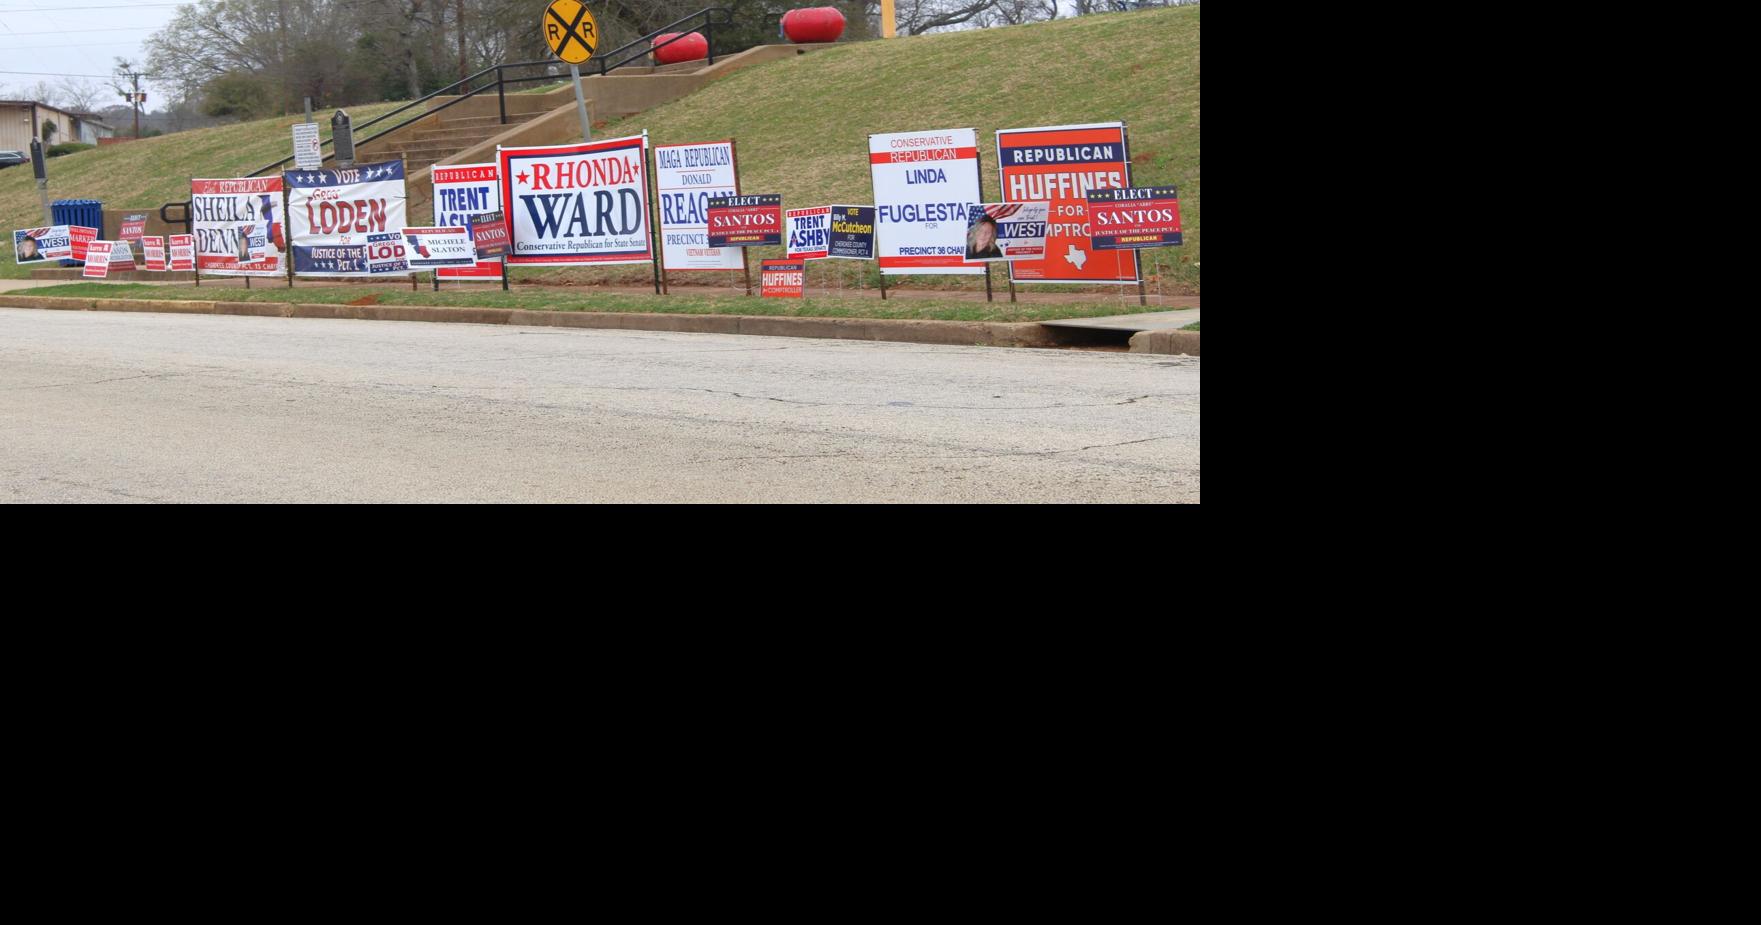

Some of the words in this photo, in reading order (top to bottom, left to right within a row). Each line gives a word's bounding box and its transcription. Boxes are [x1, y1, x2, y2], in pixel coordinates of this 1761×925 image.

[548, 24, 560, 40] R
[582, 22, 594, 38] R
[891, 136, 952, 148] CONSERVATIVE
[659, 150, 682, 169] MAGA
[685, 146, 730, 167] REPUBLICAN
[890, 149, 956, 162] REPUBLICAN
[1014, 146, 1113, 163] REPUBLICAN
[332, 169, 360, 184] VOTE
[435, 170, 494, 180] REPUBLICAN
[531, 156, 634, 190] RHONDA
[682, 174, 711, 185] DONALD
[906, 168, 946, 184] LINDA
[219, 180, 268, 192] REPUBLICAN
[1010, 171, 1121, 200] HUFFINES
[440, 187, 489, 211] TRENT
[1114, 188, 1152, 200] ELECT
[729, 196, 760, 206] ELECT
[194, 196, 255, 222] SHEILA
[519, 188, 641, 239] WARD
[661, 191, 733, 225] REAG
[789, 207, 830, 216] REPUBLICAN
[879, 202, 973, 223] FUGLESTA
[1058, 205, 1083, 216] FOR
[306, 198, 386, 234] LODEN
[480, 214, 495, 223] ELECT
[714, 214, 775, 227] SANTOS
[794, 215, 824, 230] TRENT
[1098, 209, 1173, 225] SANTOS
[832, 222, 872, 233] McCutcheon
[1004, 223, 1044, 237] WEST
[476, 229, 506, 241] SANTOS
[667, 233, 704, 245] PRECINCT
[789, 228, 829, 248] ASHBY
[42, 237, 67, 247] WEST
[249, 237, 265, 247] WEST
[517, 241, 566, 251] Conservative
[568, 239, 603, 252] Republican
[604, 238, 613, 248] for
[312, 248, 335, 259] JUSTICE
[337, 248, 346, 258] OF
[347, 248, 361, 258] THE
[900, 247, 936, 255] PRECINCT
[763, 273, 802, 286] HUFFINES
